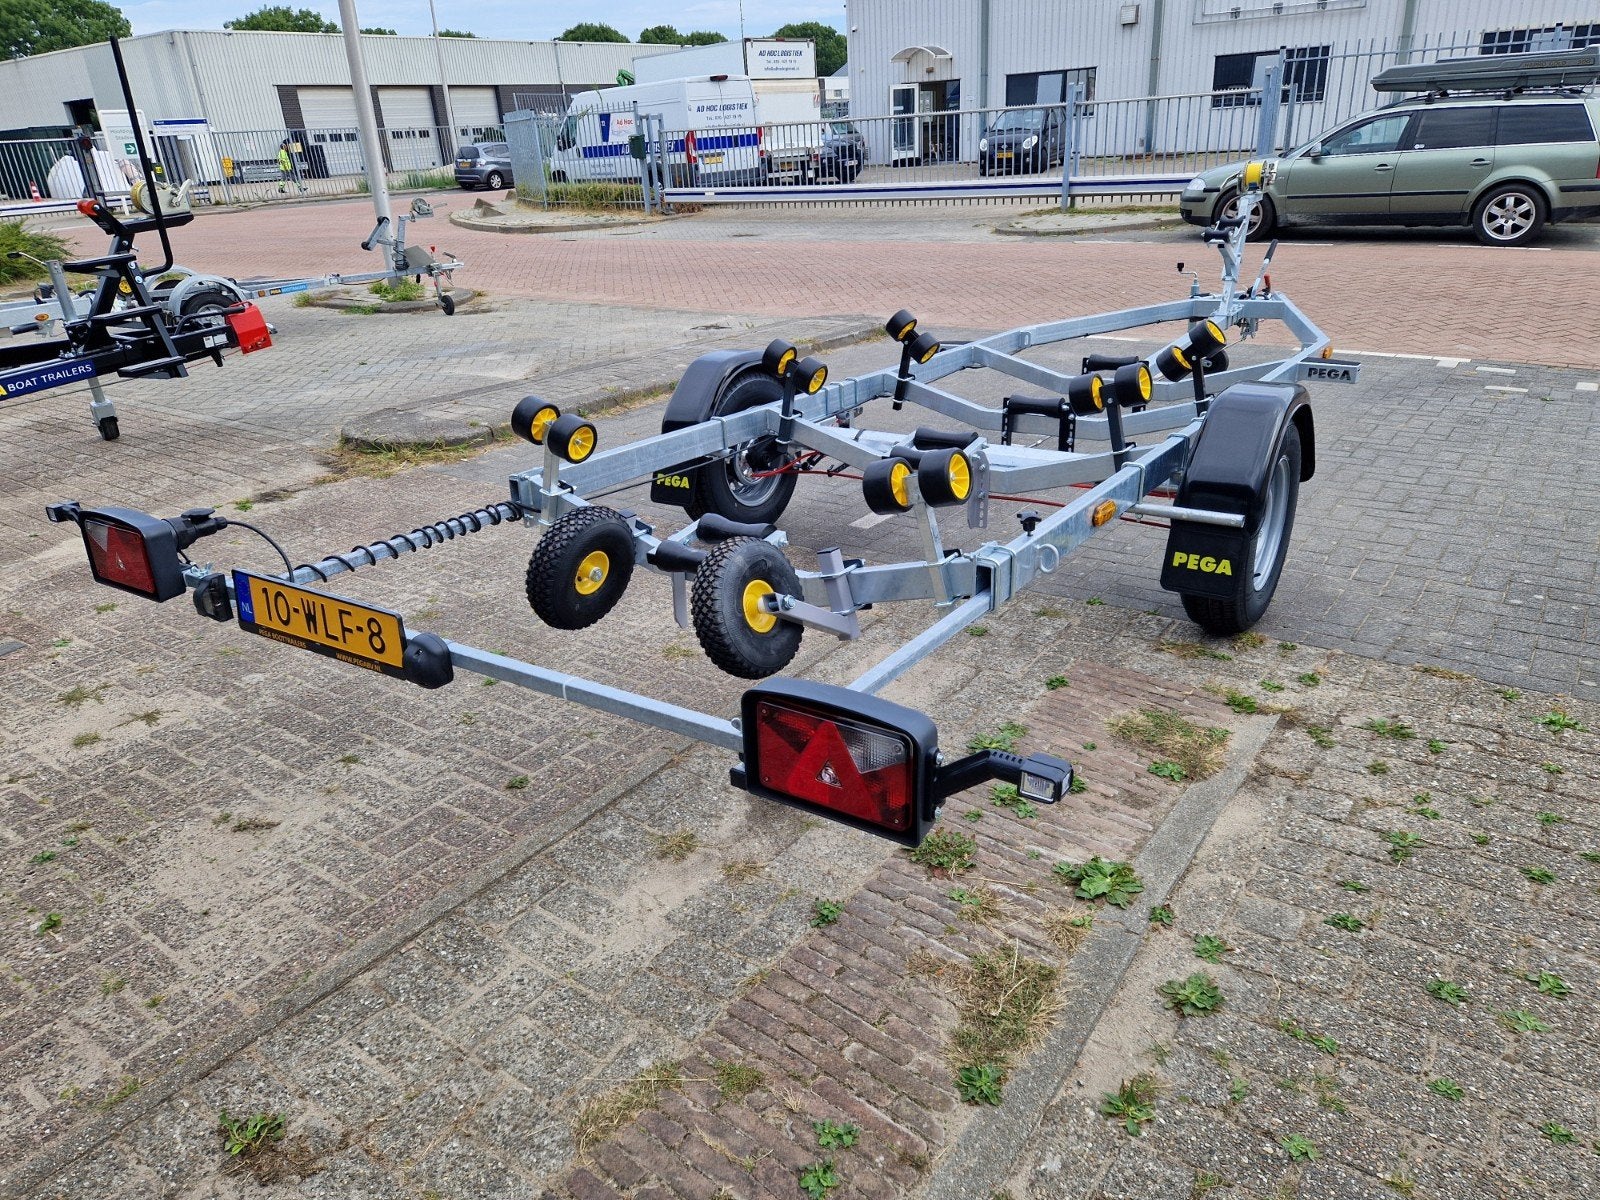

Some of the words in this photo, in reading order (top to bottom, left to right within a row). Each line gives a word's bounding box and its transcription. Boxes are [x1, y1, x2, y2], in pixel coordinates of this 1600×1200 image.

[706, 104, 718, 112] HOC
[719, 103, 748, 111] LOGISTIEK
[7, 377, 38, 392] BOAT
[41, 364, 92, 383] TRAILERS
[1308, 367, 1351, 381] PEGA
[656, 473, 690, 489] PEGA
[1172, 551, 1232, 576] PEGA
[241, 601, 253, 614] NL
[262, 587, 386, 655] 10-WLF-8
[258, 629, 272, 639] PEGA
[272, 631, 307, 649] BOOTTRAILERS
[336, 652, 382, 673] WWW.PEGABV.NL
